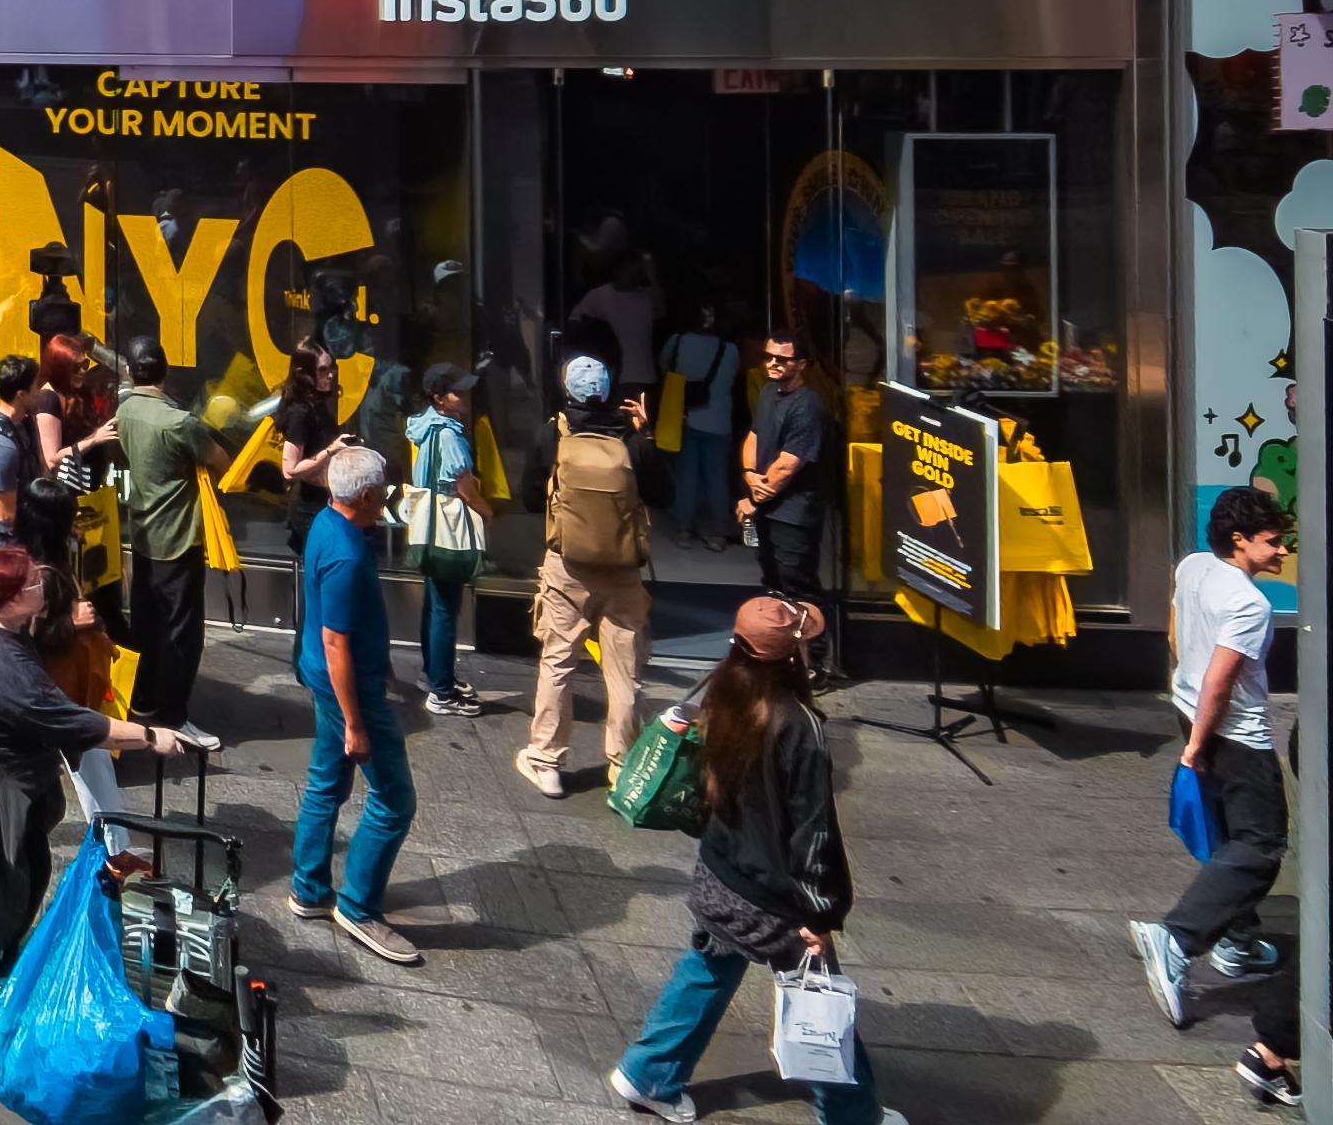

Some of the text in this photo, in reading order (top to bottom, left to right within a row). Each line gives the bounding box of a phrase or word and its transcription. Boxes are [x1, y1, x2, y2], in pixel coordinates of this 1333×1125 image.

[45, 107, 317, 140] YOUR MOMENT
[891, 420, 974, 467] GET INSIDE
[916, 444, 949, 472] WIN
[911, 460, 955, 490] GOLD
